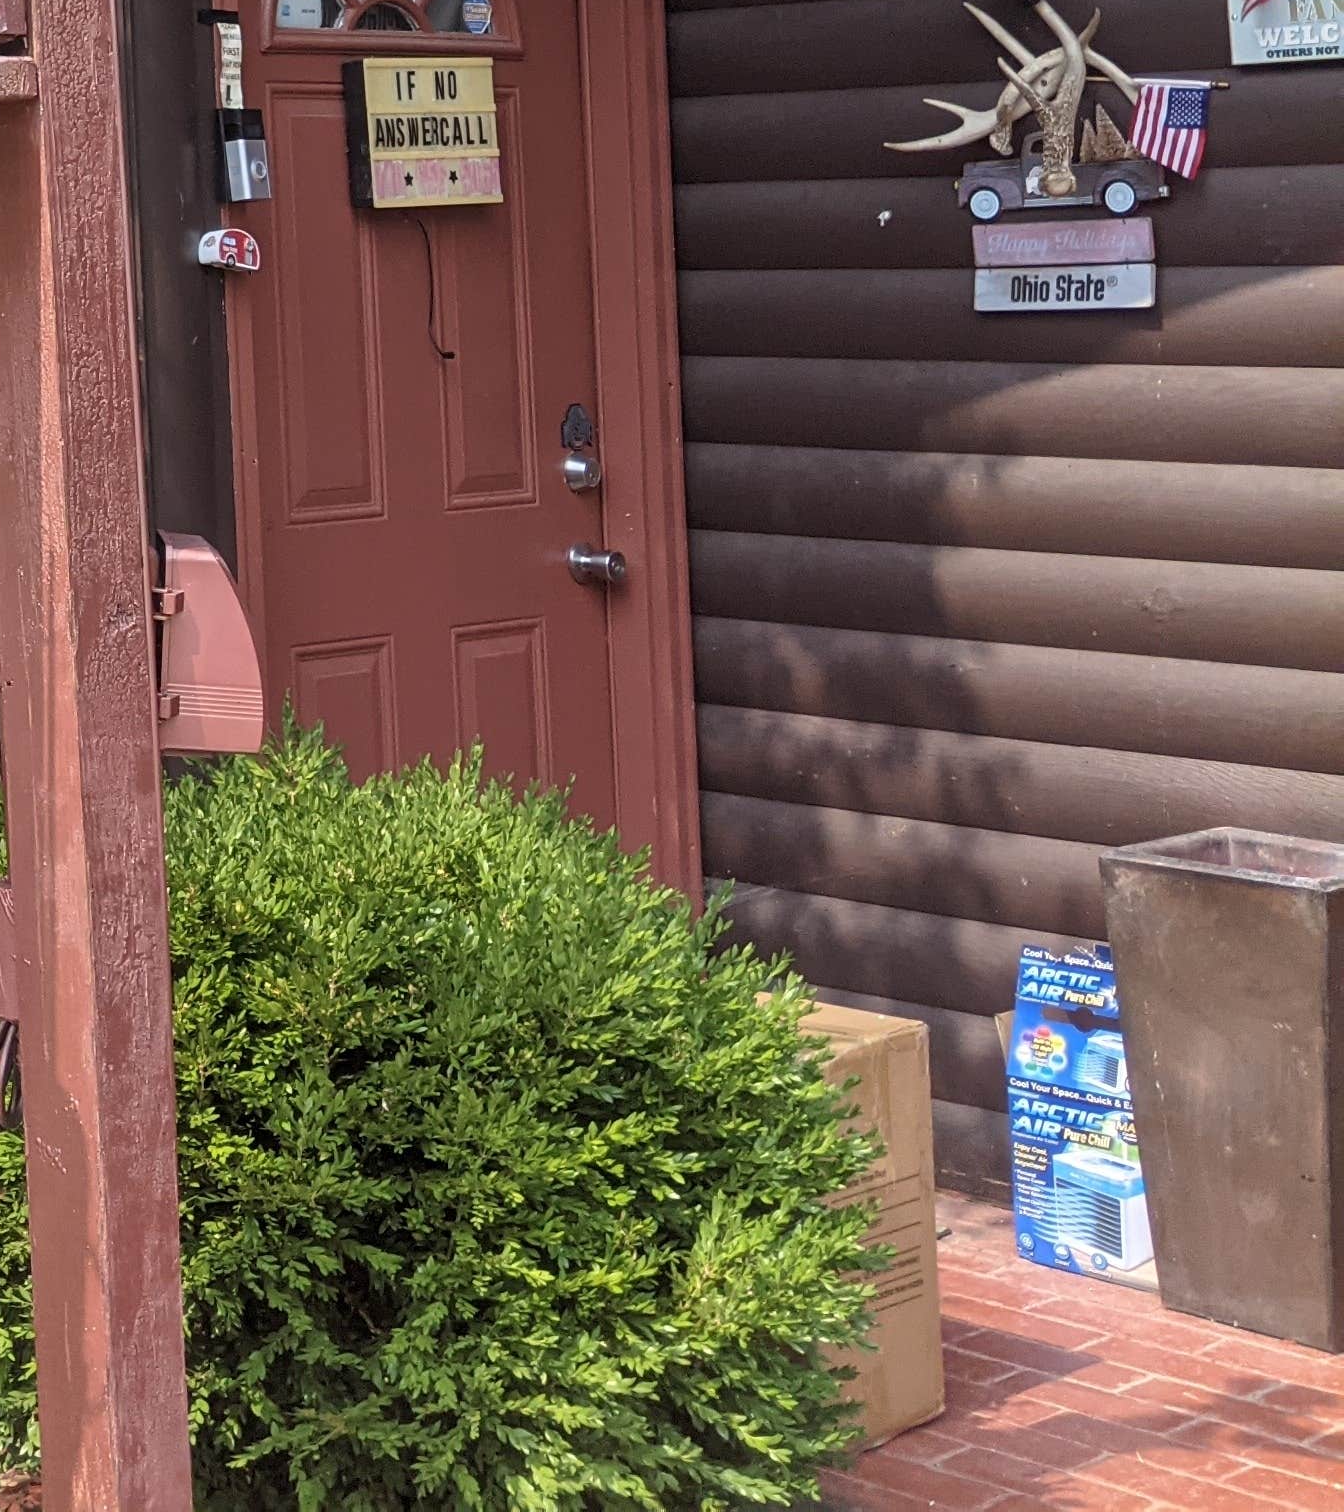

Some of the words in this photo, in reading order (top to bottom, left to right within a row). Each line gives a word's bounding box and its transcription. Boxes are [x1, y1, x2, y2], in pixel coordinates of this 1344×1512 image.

[1254, 23, 1344, 48] WELC
[1266, 48, 1313, 59] OTHERS
[1315, 46, 1340, 56] NOT
[395, 71, 416, 101] IF
[434, 70, 457, 100] NO
[1011, 275, 1050, 303] Ohio
[1022, 966, 1101, 990] ARCTIC
[1020, 981, 1064, 1001] AIR
[1064, 989, 1086, 1004] Pure
[1084, 992, 1105, 1007] Chill
[1009, 1077, 1030, 1089] Cool
[1031, 1081, 1051, 1094] Your
[1114, 1099, 1122, 1108] &
[1012, 1097, 1105, 1131] ARCTIC
[1012, 1115, 1062, 1140] AIR
[1063, 1128, 1087, 1145] Pure
[1087, 1132, 1111, 1148] Chill
